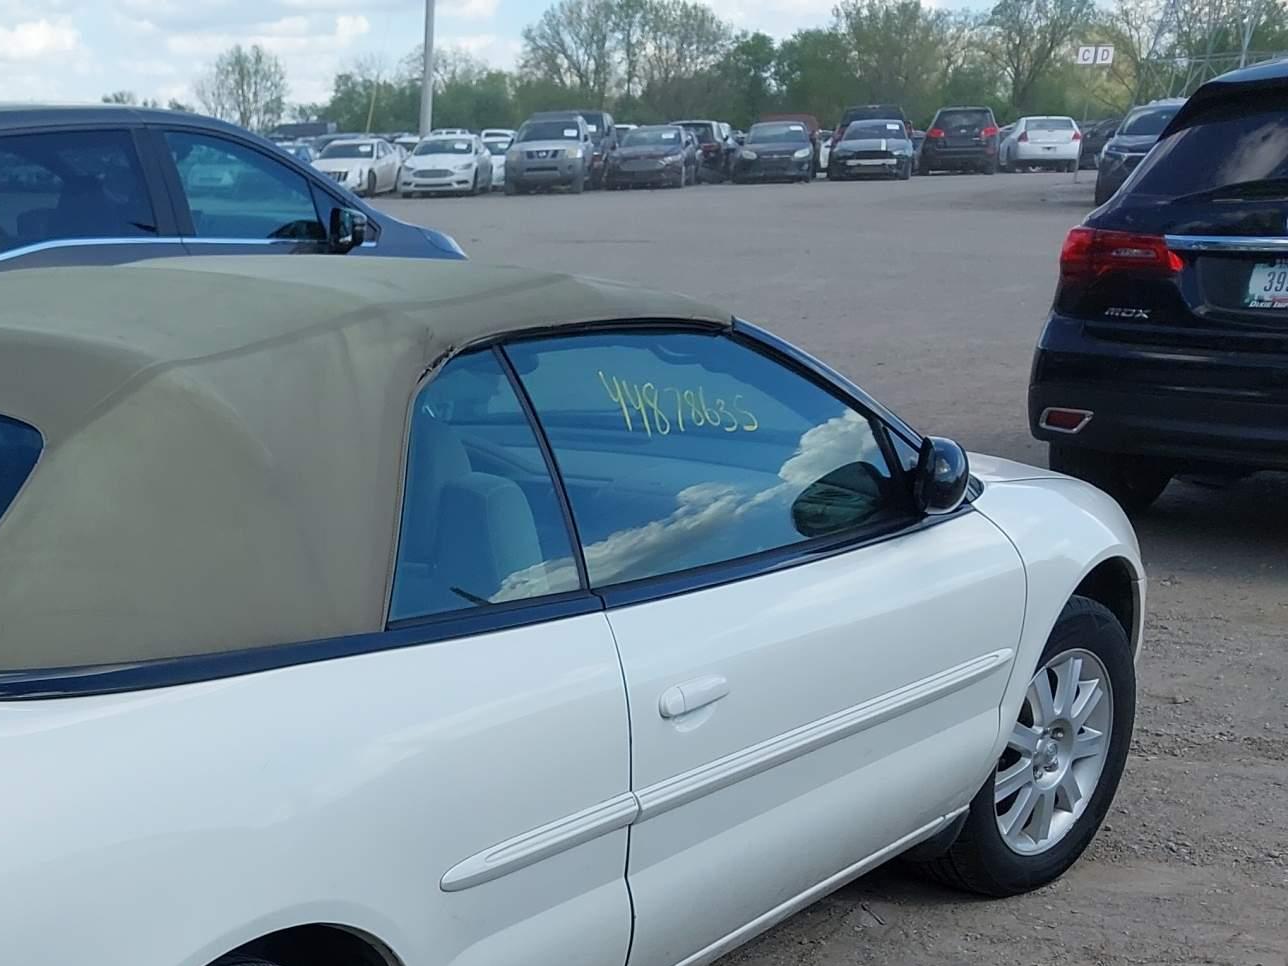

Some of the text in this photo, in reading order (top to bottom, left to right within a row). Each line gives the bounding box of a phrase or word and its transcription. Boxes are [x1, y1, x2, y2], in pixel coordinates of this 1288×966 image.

[1082, 48, 1110, 62] C D
[1263, 270, 1288, 293] 39
[598, 370, 759, 440] 44878635
